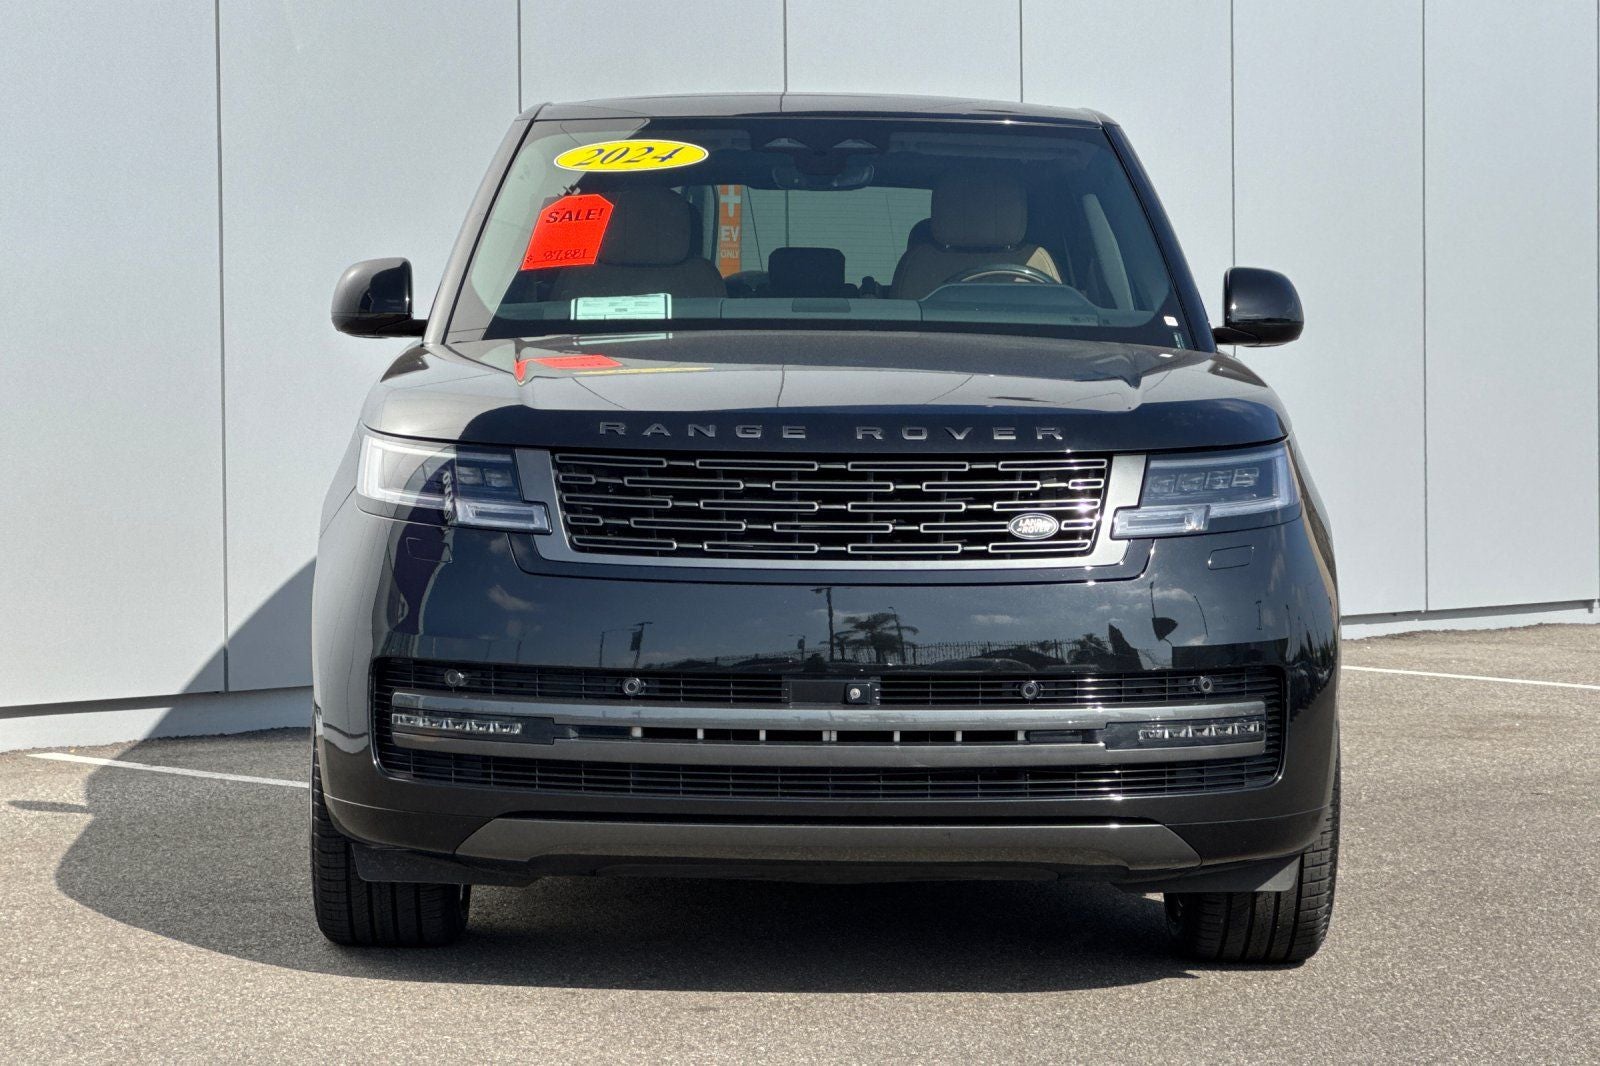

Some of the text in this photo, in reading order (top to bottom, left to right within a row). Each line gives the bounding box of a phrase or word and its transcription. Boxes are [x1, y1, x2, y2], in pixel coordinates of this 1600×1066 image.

[573, 146, 685, 167] 2024
[546, 207, 604, 223] SALE!
[720, 226, 739, 241] EV
[599, 421, 1063, 440] RANGE ROVER
[1019, 518, 1042, 527] LAND
